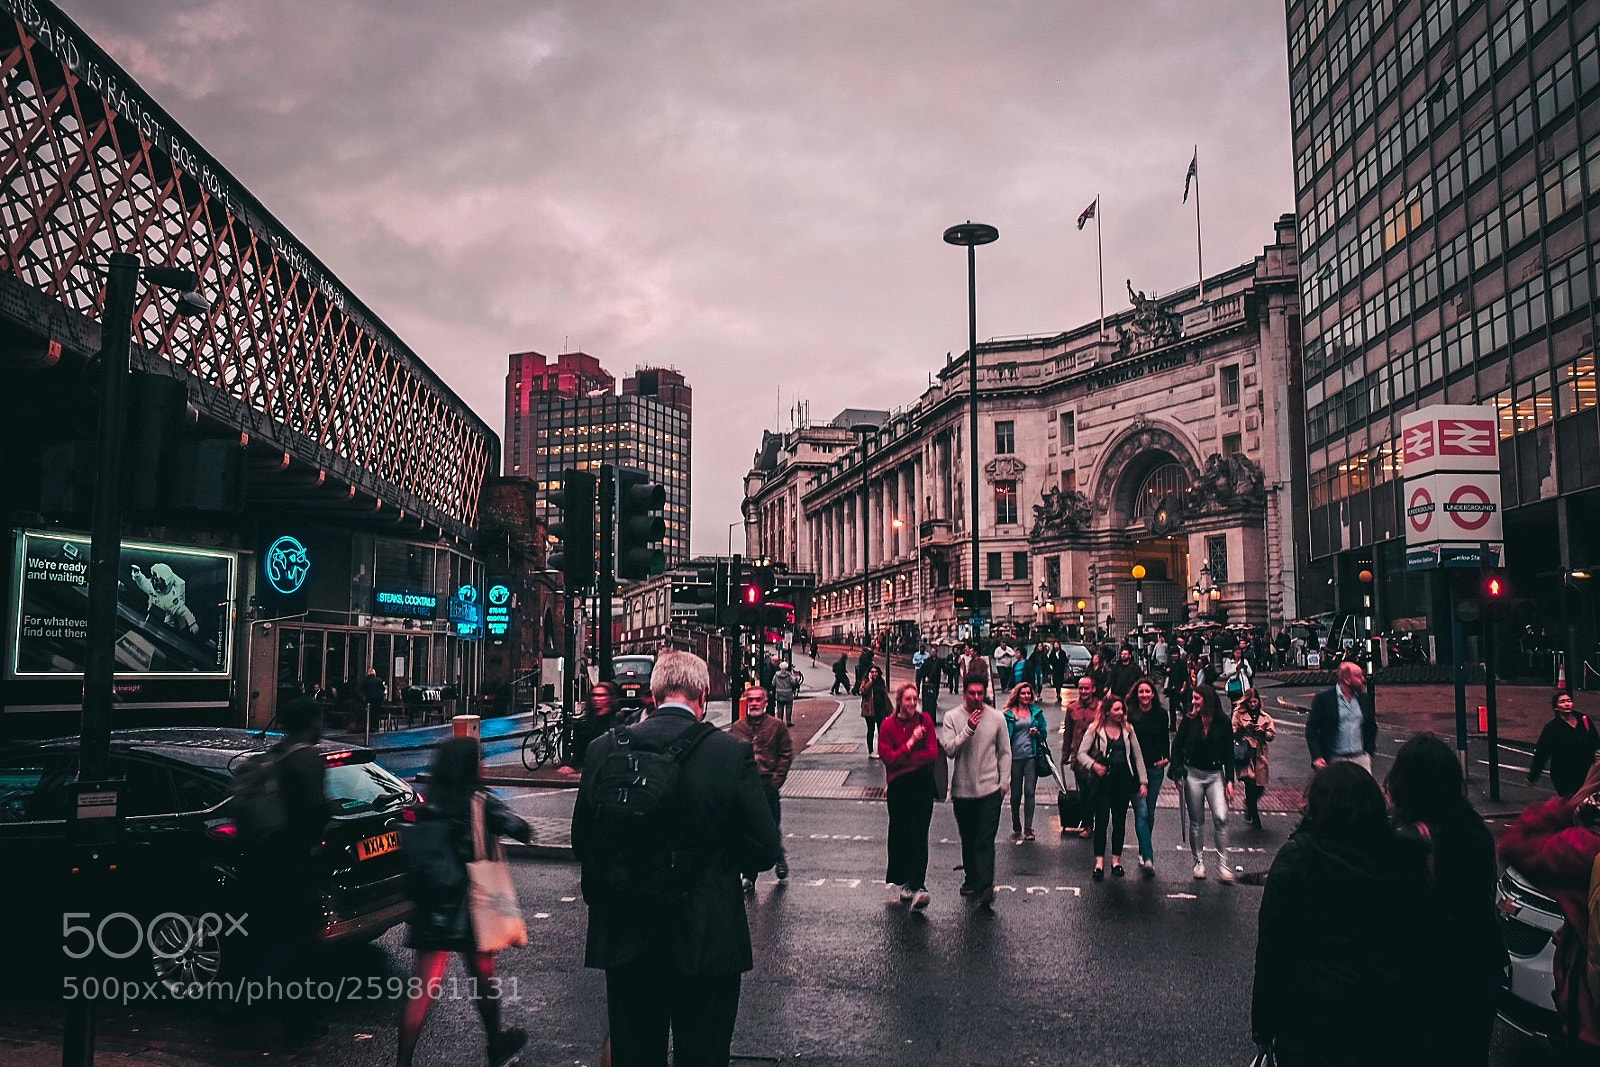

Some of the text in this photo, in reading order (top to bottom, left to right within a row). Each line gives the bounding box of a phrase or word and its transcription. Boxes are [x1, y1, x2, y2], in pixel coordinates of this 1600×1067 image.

[86, 61, 103, 91] IS
[1098, 355, 1187, 388] WATERLOO STATION
[1408, 504, 1434, 515] UNDERGROUND
[28, 557, 87, 574] We're ready
[27, 570, 87, 585] and waiting.
[379, 592, 436, 607] STEAKS, COCKTAILS
[24, 615, 42, 625] For
[23, 626, 43, 637] find
[45, 628, 63, 638] out
